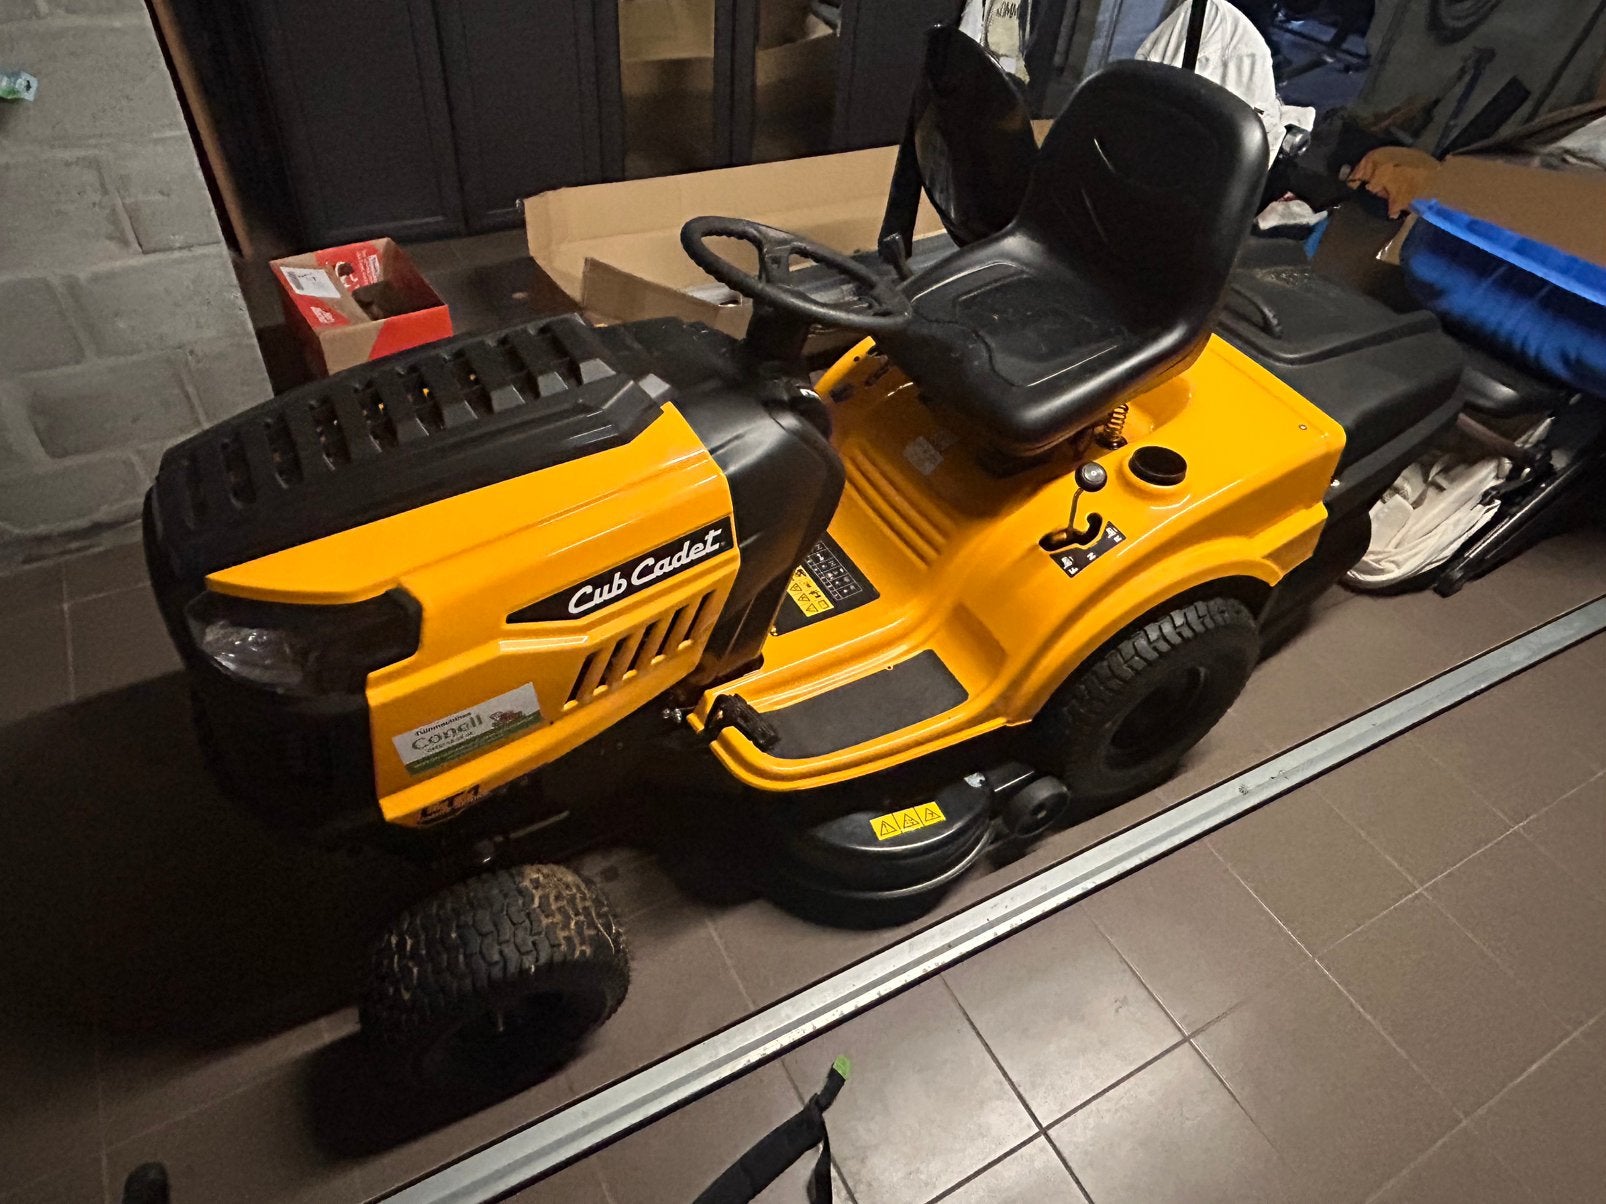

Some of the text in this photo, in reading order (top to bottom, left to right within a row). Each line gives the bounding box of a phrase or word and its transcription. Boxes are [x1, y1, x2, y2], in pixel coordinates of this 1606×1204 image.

[1086, 552, 1096, 561] N
[568, 528, 722, 614] Cub Cadet
[1068, 567, 1079, 575] F
